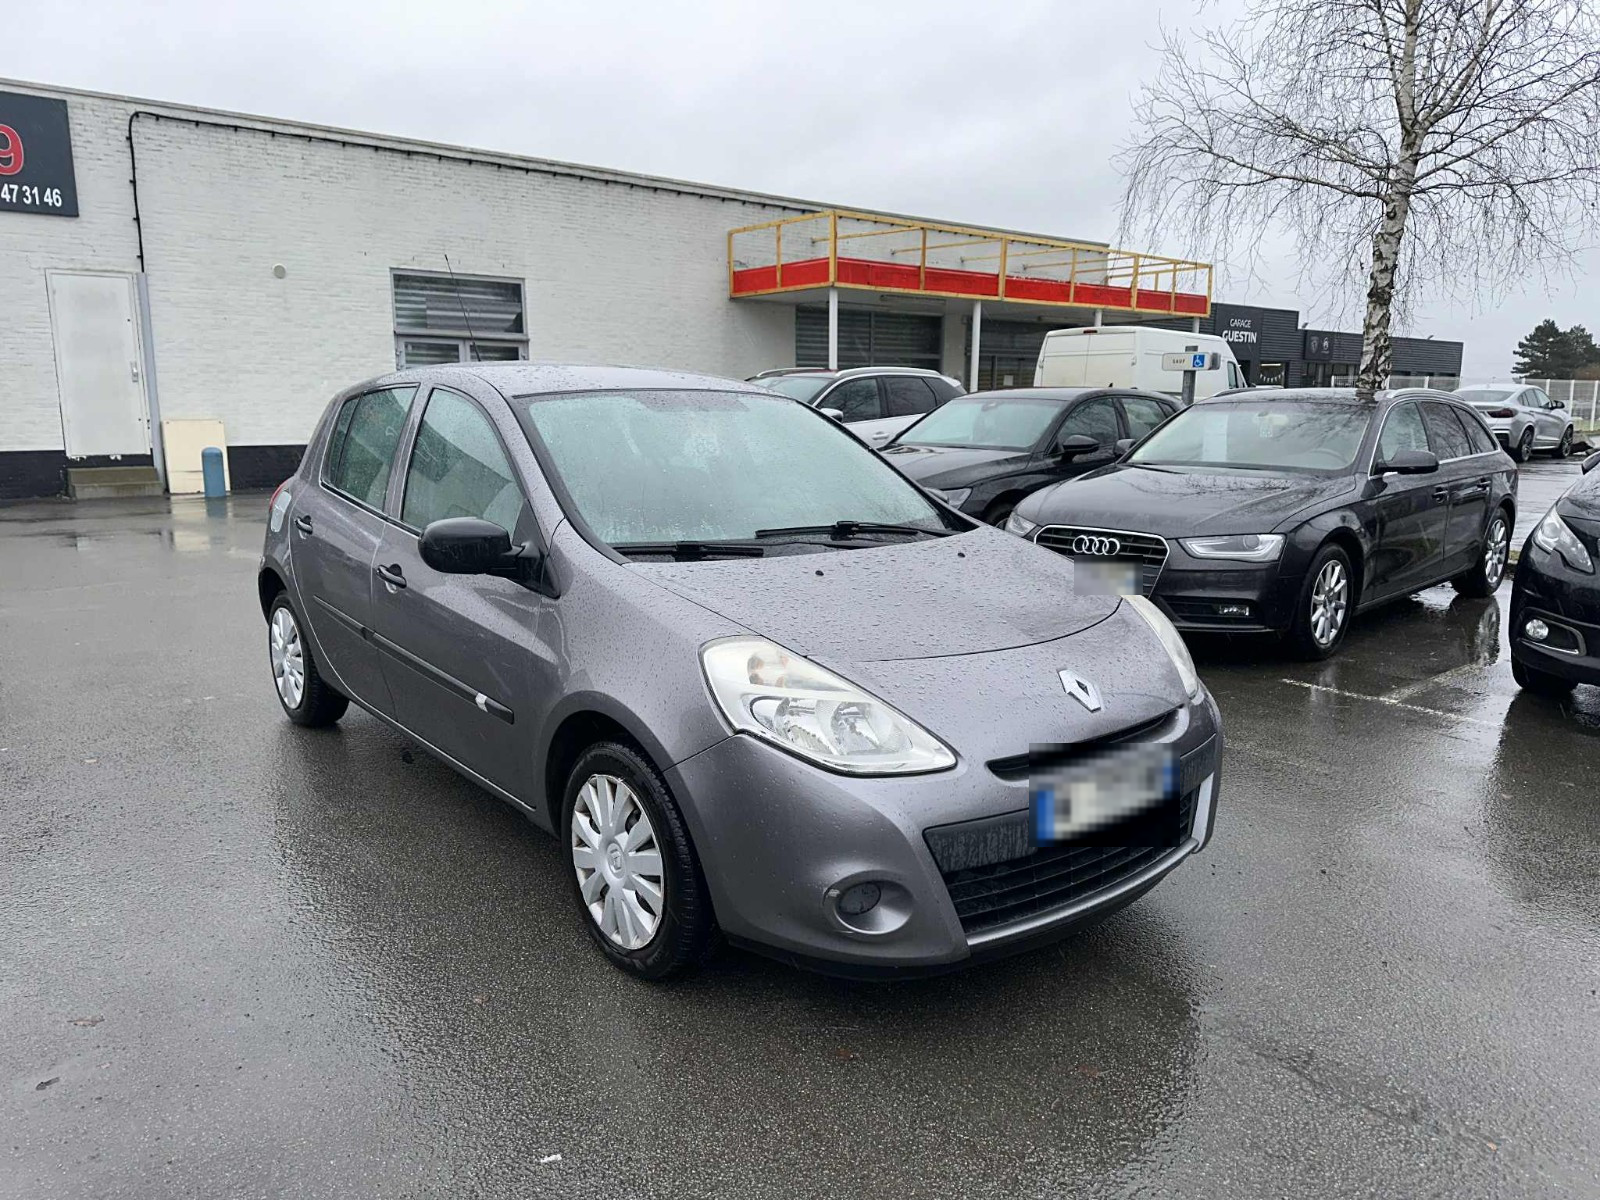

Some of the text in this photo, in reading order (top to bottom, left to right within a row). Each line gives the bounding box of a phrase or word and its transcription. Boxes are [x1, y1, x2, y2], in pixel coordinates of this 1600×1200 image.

[1, 183, 62, 207] 47 31 46
[1230, 318, 1252, 328] GARAGE
[1222, 330, 1257, 343] GUESTIN
